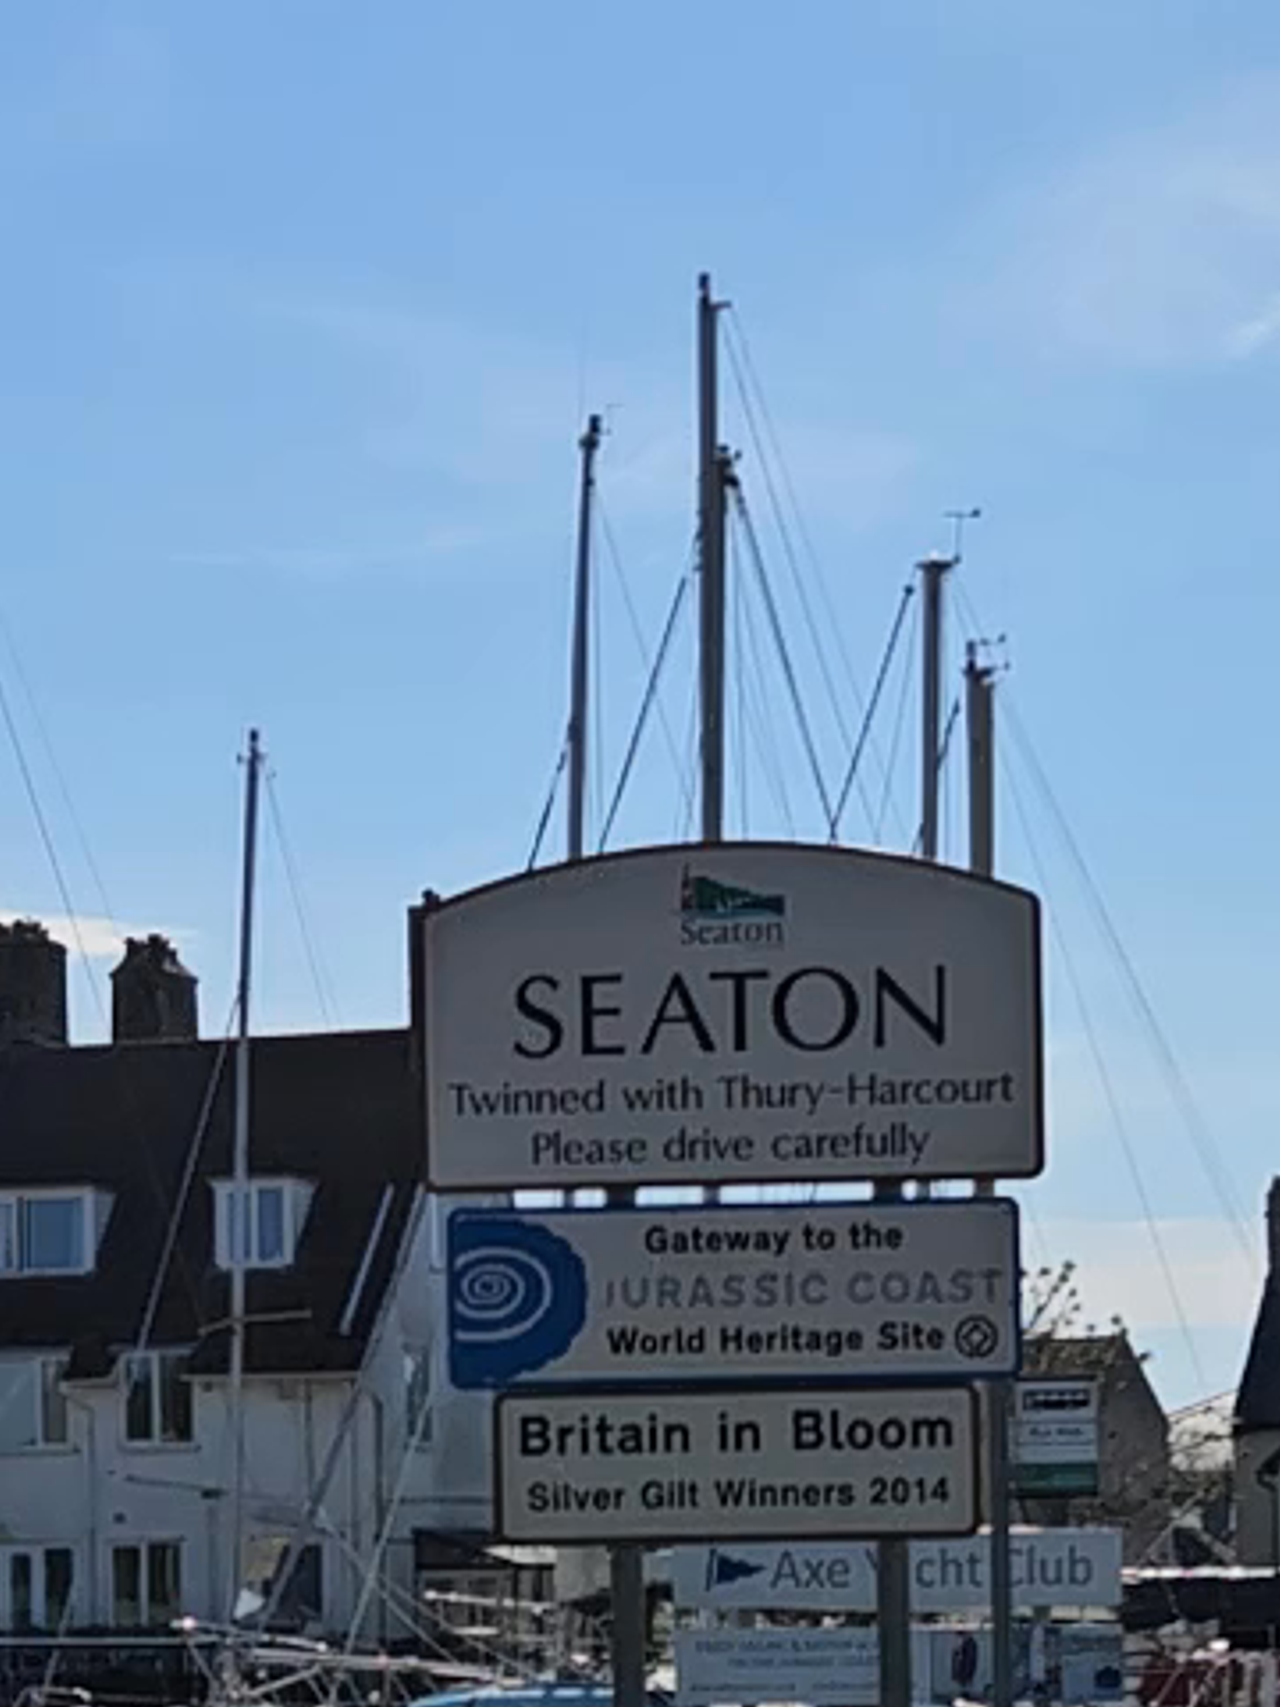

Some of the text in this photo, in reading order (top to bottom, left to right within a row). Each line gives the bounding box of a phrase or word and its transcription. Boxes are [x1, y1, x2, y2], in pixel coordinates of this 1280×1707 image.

[680, 918, 784, 946] Seaton
[513, 964, 947, 1060] SEATON
[448, 1071, 1014, 1117] Twinned with Thury-Harcourt
[531, 1121, 930, 1166] Please drive carefully
[644, 1221, 903, 1256] Gateway to the
[847, 1268, 1003, 1304] COAST
[607, 1320, 946, 1358] World Heritage Site
[520, 1408, 954, 1458] Britain in Bloom
[527, 1476, 950, 1513] Silver Gilt Winners 2014
[769, 1550, 851, 1590] Axe
[865, 1547, 984, 1588] cht
